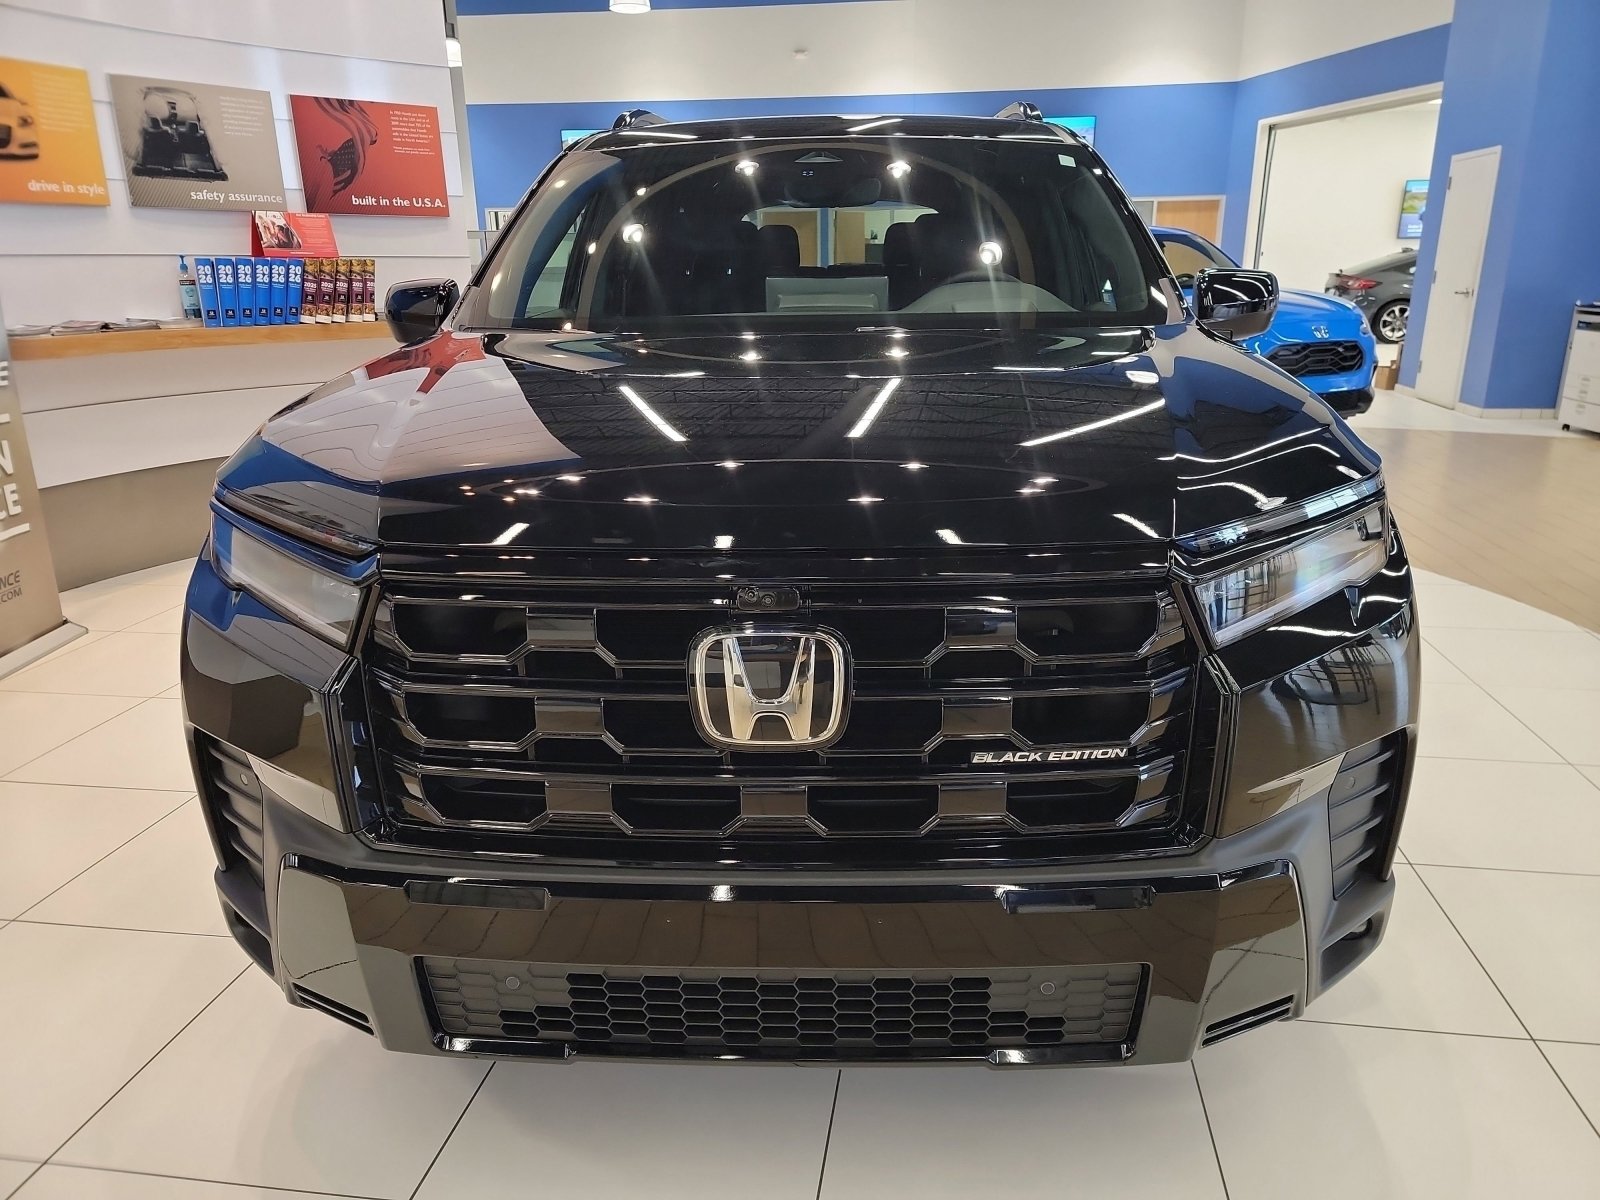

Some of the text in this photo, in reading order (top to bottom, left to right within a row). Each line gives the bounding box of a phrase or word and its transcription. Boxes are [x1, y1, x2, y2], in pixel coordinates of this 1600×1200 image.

[28, 180, 104, 197] drive in style
[190, 190, 283, 203] safety assurance
[351, 195, 446, 208] built in the U.S.A.
[197, 265, 211, 275] 20
[217, 265, 232, 275] 20
[237, 264, 251, 275] 20
[256, 264, 269, 275] 20
[271, 264, 285, 275] 20
[288, 264, 302, 275] 20
[199, 274, 213, 284] 26
[219, 274, 233, 284] 26
[238, 274, 252, 283] 26
[256, 273, 269, 283] 26
[271, 273, 285, 283] 26
[288, 273, 302, 283] 26
[971, 748, 1127, 763] BLACK EDITION
